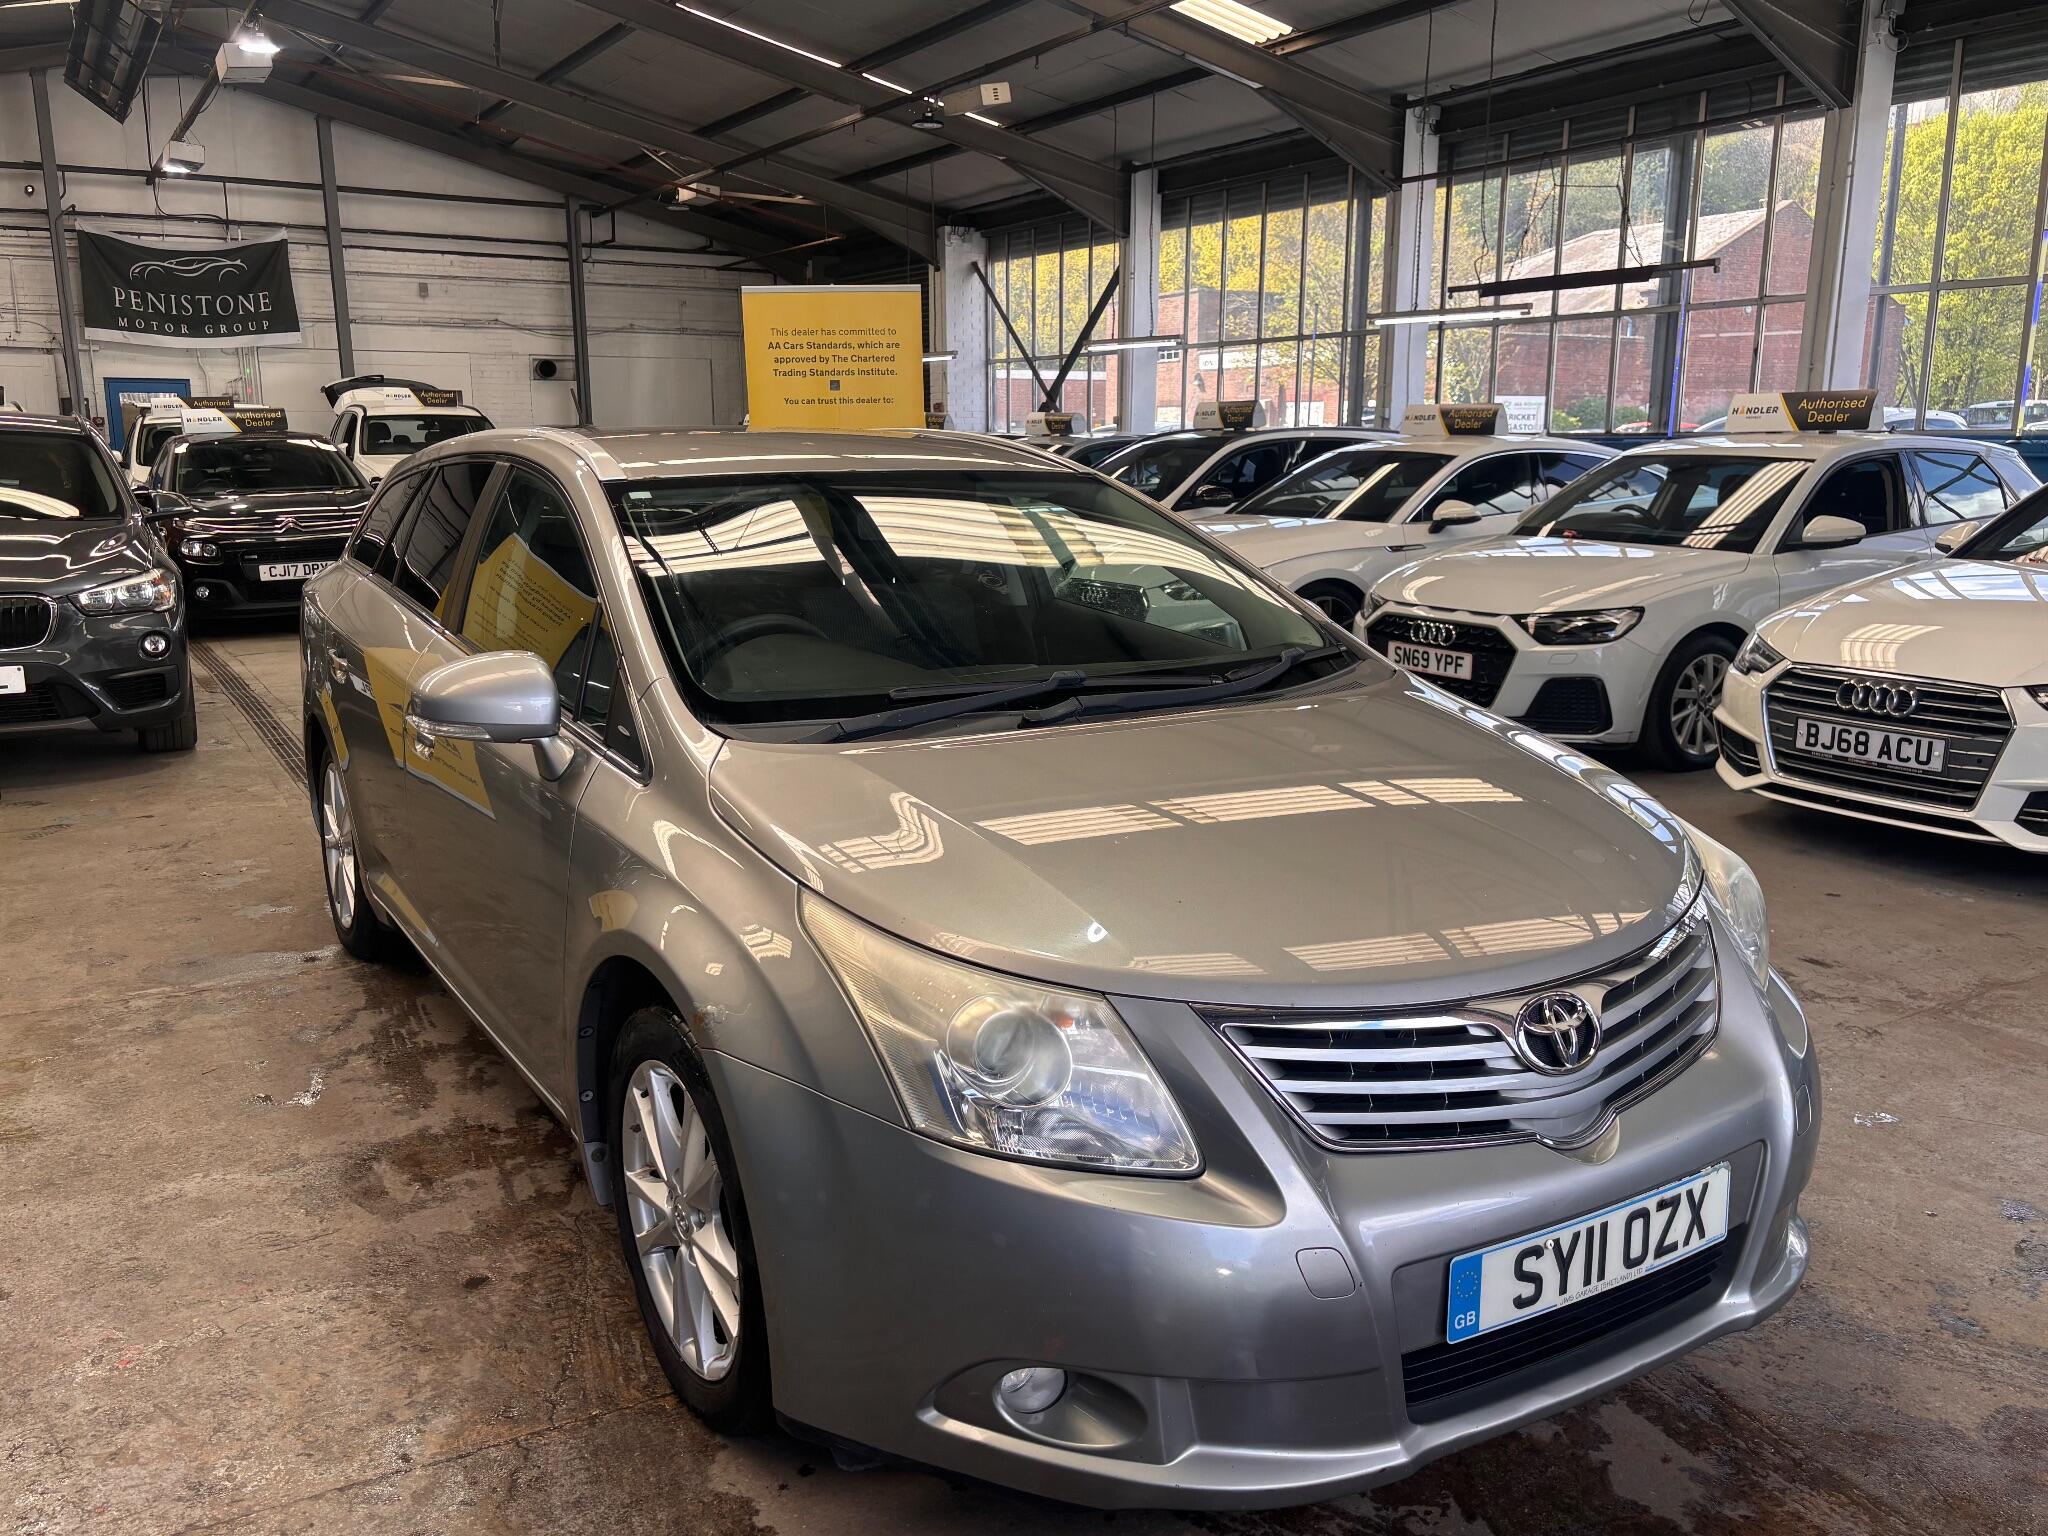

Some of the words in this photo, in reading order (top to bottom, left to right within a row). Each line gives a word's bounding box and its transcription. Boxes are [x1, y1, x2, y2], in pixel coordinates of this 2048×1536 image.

[112, 286, 272, 316] PENISTONE
[118, 317, 189, 333] MOTOR
[205, 320, 269, 334] GROUP
[770, 328, 788, 336] This
[791, 328, 819, 336] dealer
[821, 328, 836, 336] has
[838, 328, 885, 336] committed
[888, 328, 896, 336] to
[768, 342, 781, 350] AA
[784, 342, 804, 350] Cars
[806, 341, 855, 350] Standards,
[858, 341, 884, 349] which
[774, 356, 816, 364] approved
[819, 355, 830, 364] by
[850, 354, 895, 362] Chartered
[773, 368, 806, 378] Trading
[809, 368, 856, 376] Standards
[858, 368, 898, 376] Institute.
[856, 396, 880, 404] dealer
[883, 396, 894, 404] to:
[1798, 396, 1867, 410] Authorised
[236, 411, 282, 419] Authorised
[1448, 408, 1493, 418] Authorised
[1732, 405, 1778, 416] HANDLER
[1808, 410, 1850, 422] Dealer
[1454, 419, 1482, 429] Dealer
[268, 564, 298, 577] CJ17
[1394, 646, 1430, 668] SN69
[1435, 652, 1464, 674] YPF
[1804, 722, 1870, 756] BJ68
[1877, 734, 1934, 766] ACU
[1512, 1220, 1608, 1310] SY11
[1622, 1181, 1710, 1270] OZX
[1634, 1268, 1643, 1277] LTD
[1454, 1310, 1476, 1330] GB
